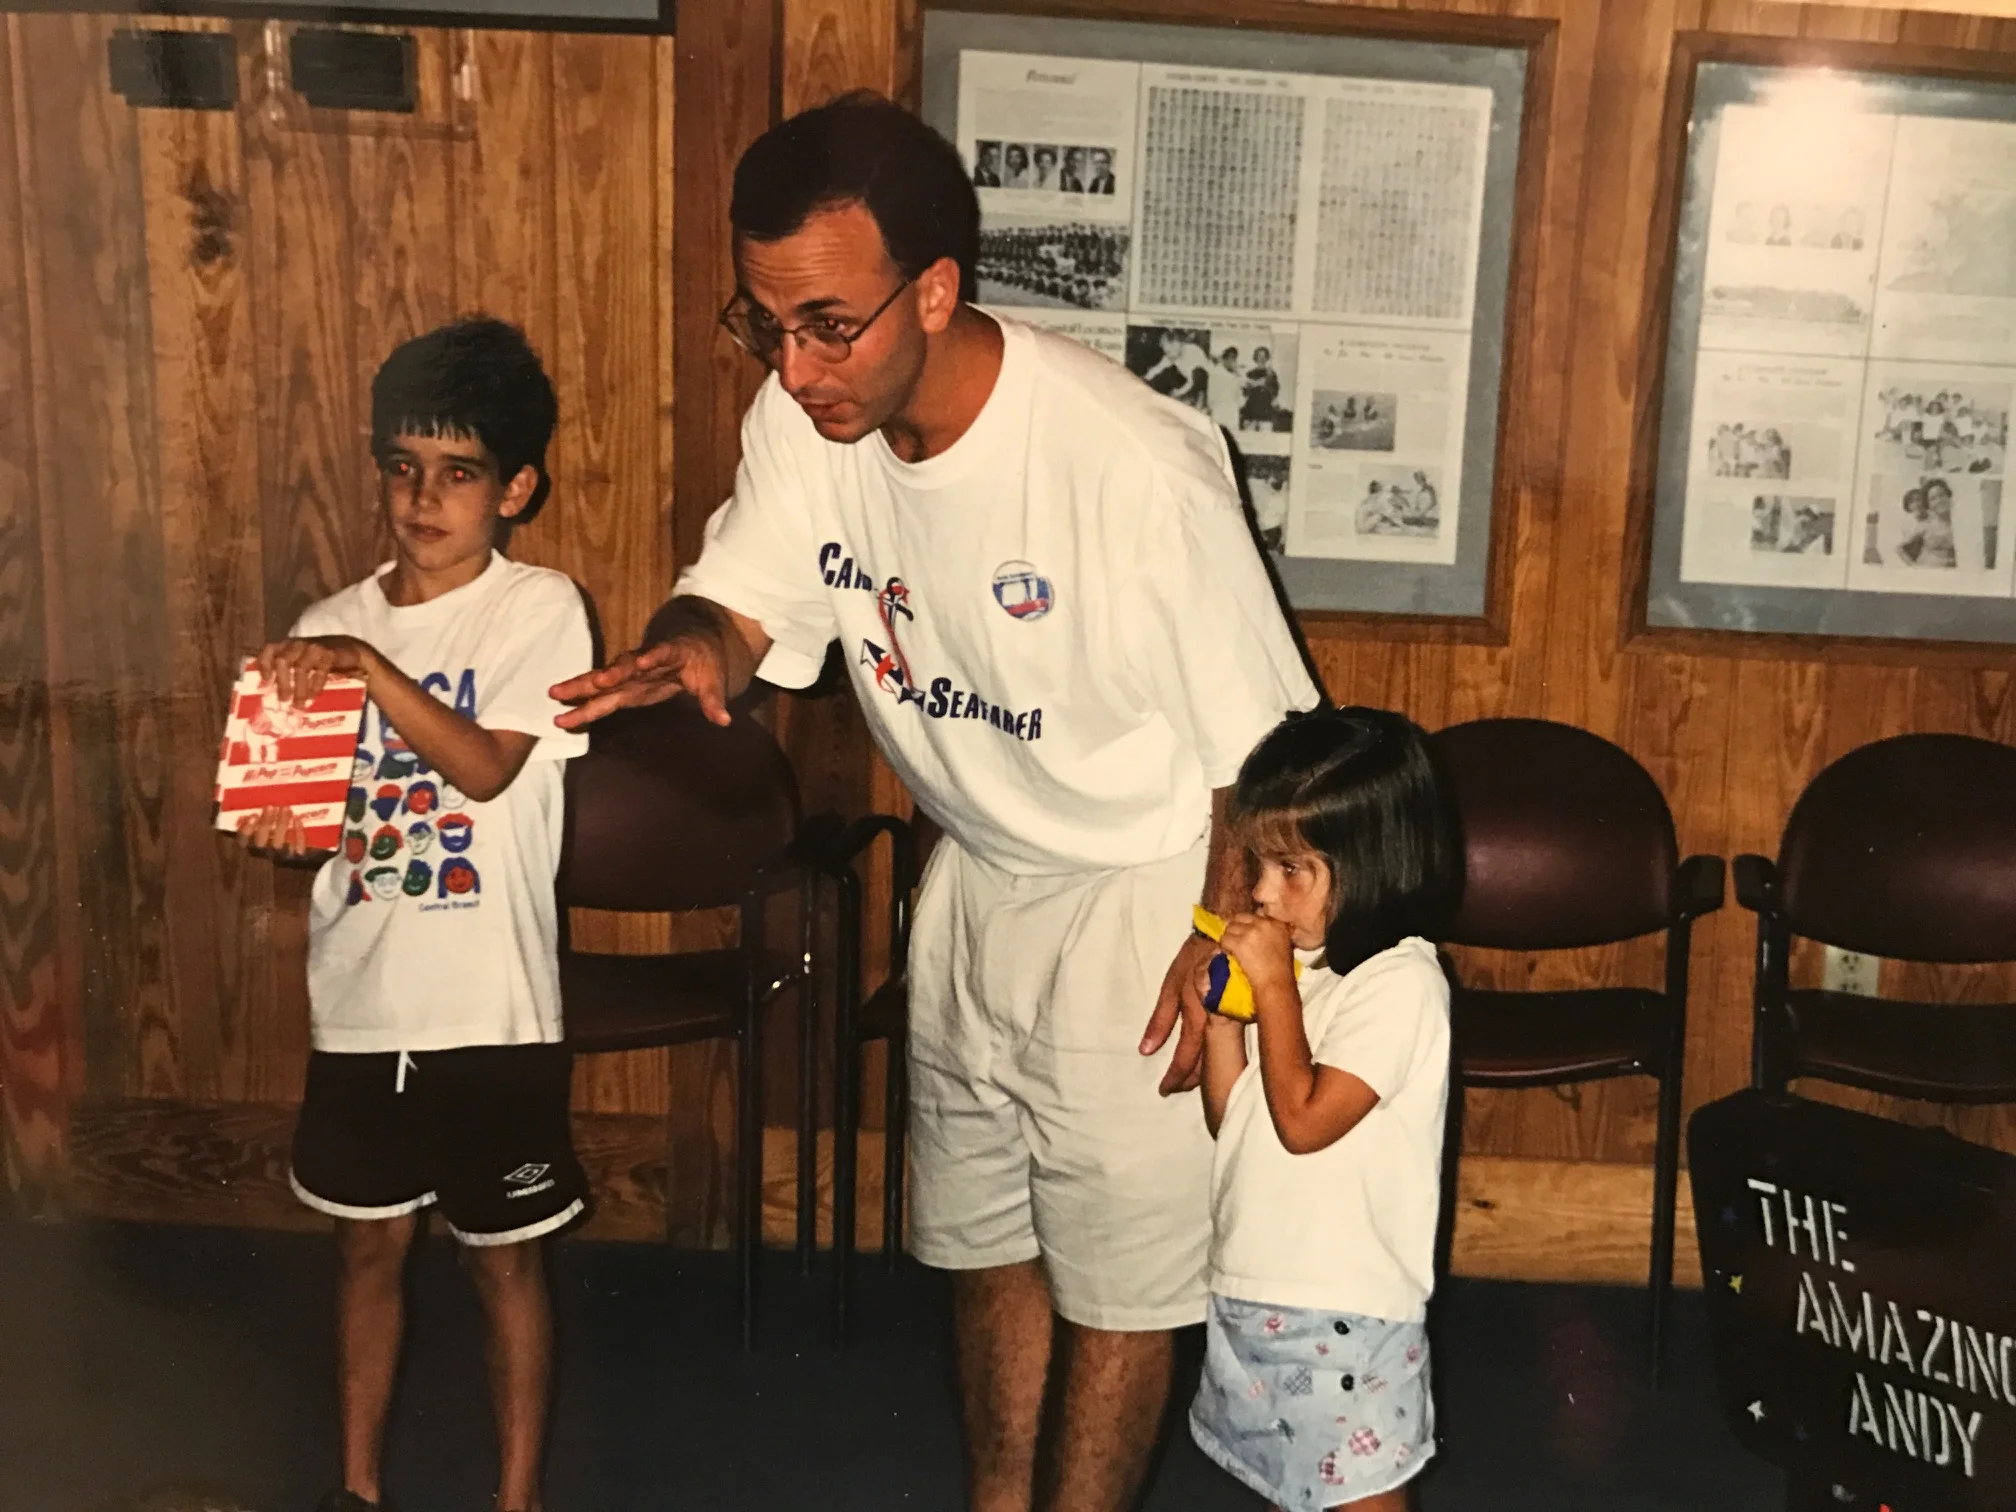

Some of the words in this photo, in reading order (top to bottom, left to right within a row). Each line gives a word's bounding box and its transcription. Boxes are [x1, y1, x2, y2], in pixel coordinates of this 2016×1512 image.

[927, 677, 1042, 741] SEAFARER
[1747, 1178, 1855, 1272] THE
[1848, 1372, 1981, 1477] ANDY
